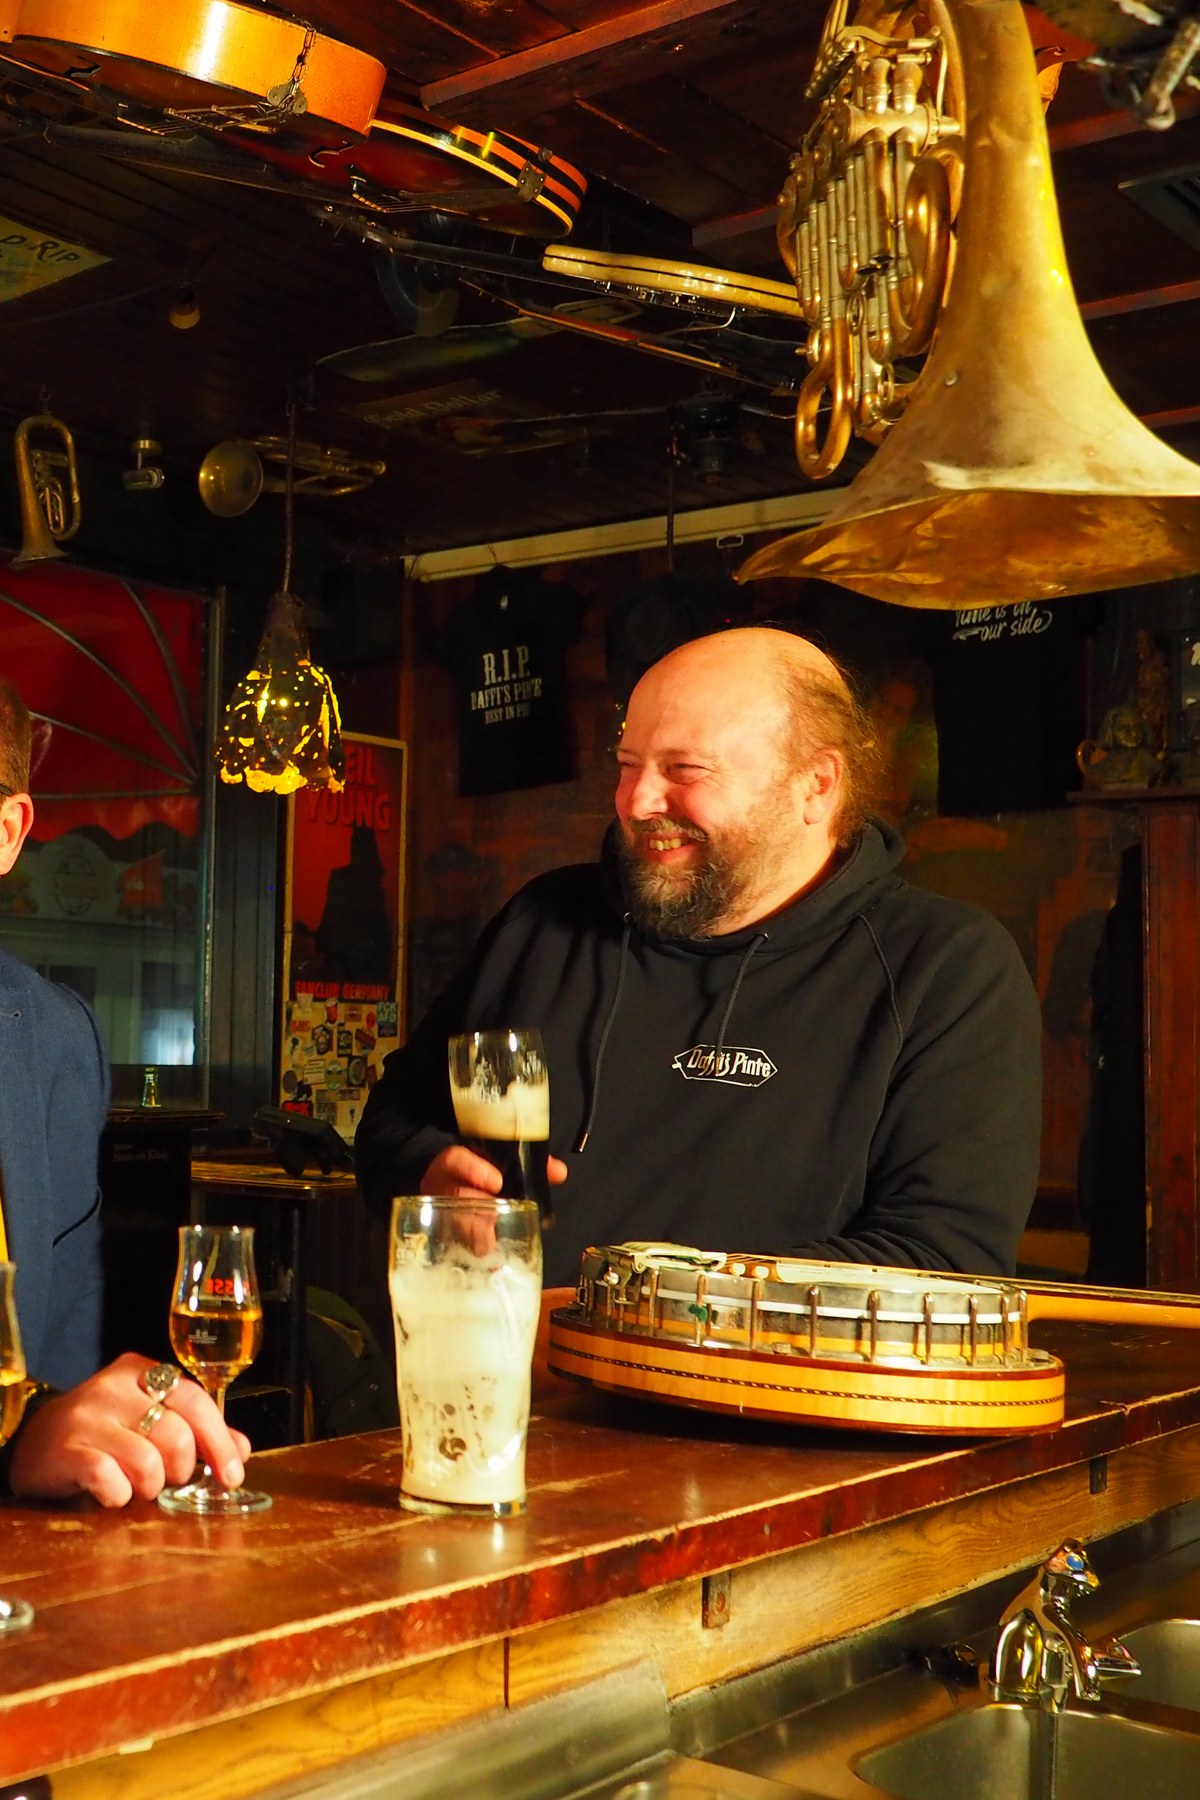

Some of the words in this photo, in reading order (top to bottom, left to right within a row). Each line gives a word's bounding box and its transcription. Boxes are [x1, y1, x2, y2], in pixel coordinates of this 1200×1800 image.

[32, 239, 81, 263] RIP
[980, 621, 1008, 641] our
[1010, 606, 1048, 637] side
[483, 645, 530, 686] R.I.P.
[345, 745, 376, 786] EIL
[304, 787, 391, 831] YOUNG
[295, 980, 340, 999] FANCLUB
[342, 983, 391, 1001] GERMANY
[378, 1001, 397, 1012] FCK
[378, 1012, 397, 1023] AFD
[729, 1051, 772, 1078] Pinte
